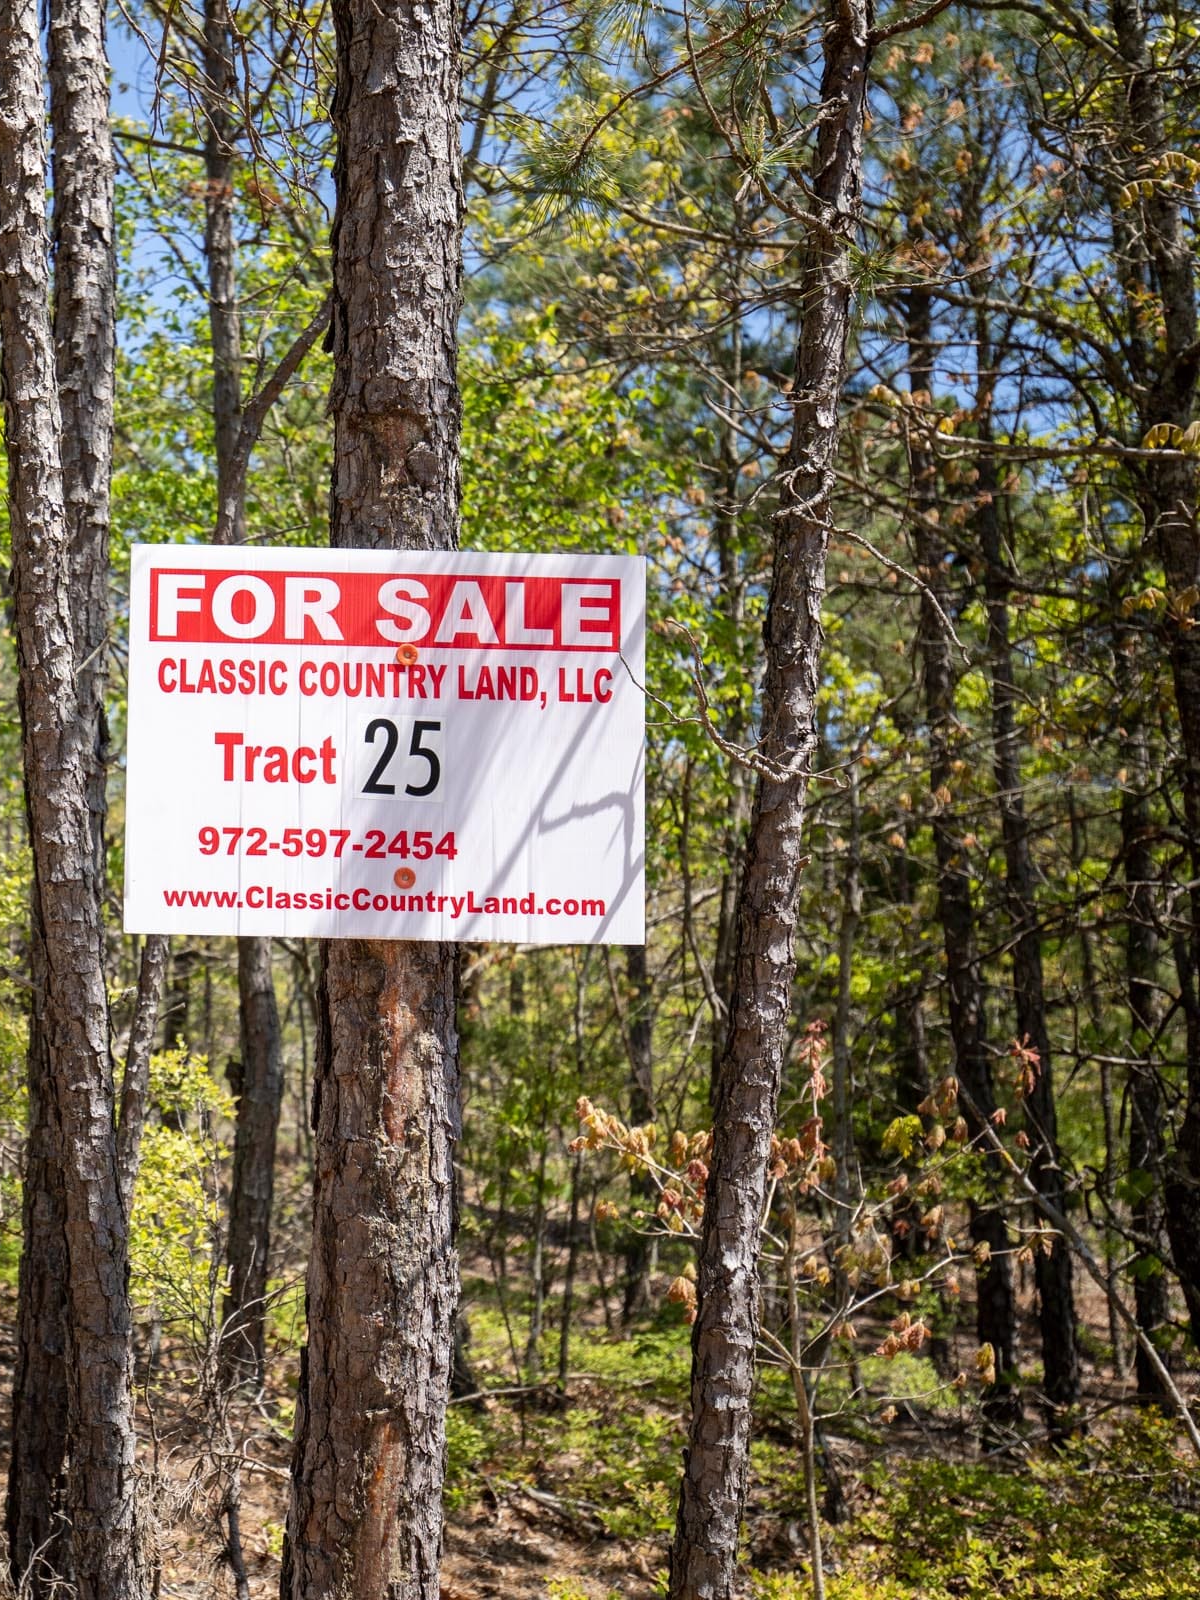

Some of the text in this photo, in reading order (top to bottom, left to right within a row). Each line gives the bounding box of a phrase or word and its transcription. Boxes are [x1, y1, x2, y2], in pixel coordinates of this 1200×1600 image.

[157, 573, 613, 647] FOR SALE
[158, 657, 613, 710] CLASSIC COUNTRY LAND, LLC
[215, 719, 441, 796] Tract 25
[199, 826, 457, 860] 972-597-2454
[163, 885, 606, 918] www.ClassicCountryLand.com
